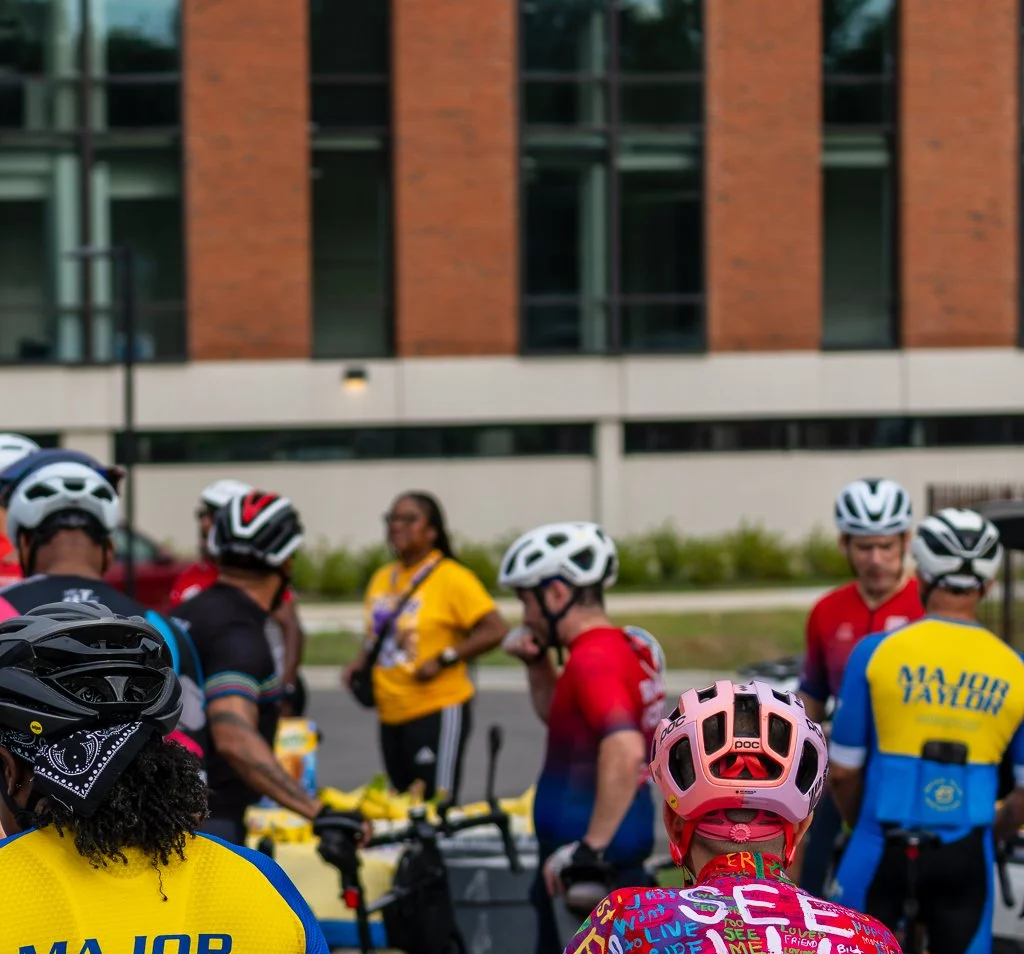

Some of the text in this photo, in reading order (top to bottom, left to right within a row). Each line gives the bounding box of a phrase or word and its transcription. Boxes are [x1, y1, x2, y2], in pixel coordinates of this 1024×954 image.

[898, 664, 1010, 699] MAJOR
[902, 682, 1004, 717] TAYLOR
[678, 884, 856, 940] SEE
[723, 927, 761, 942] SEE
